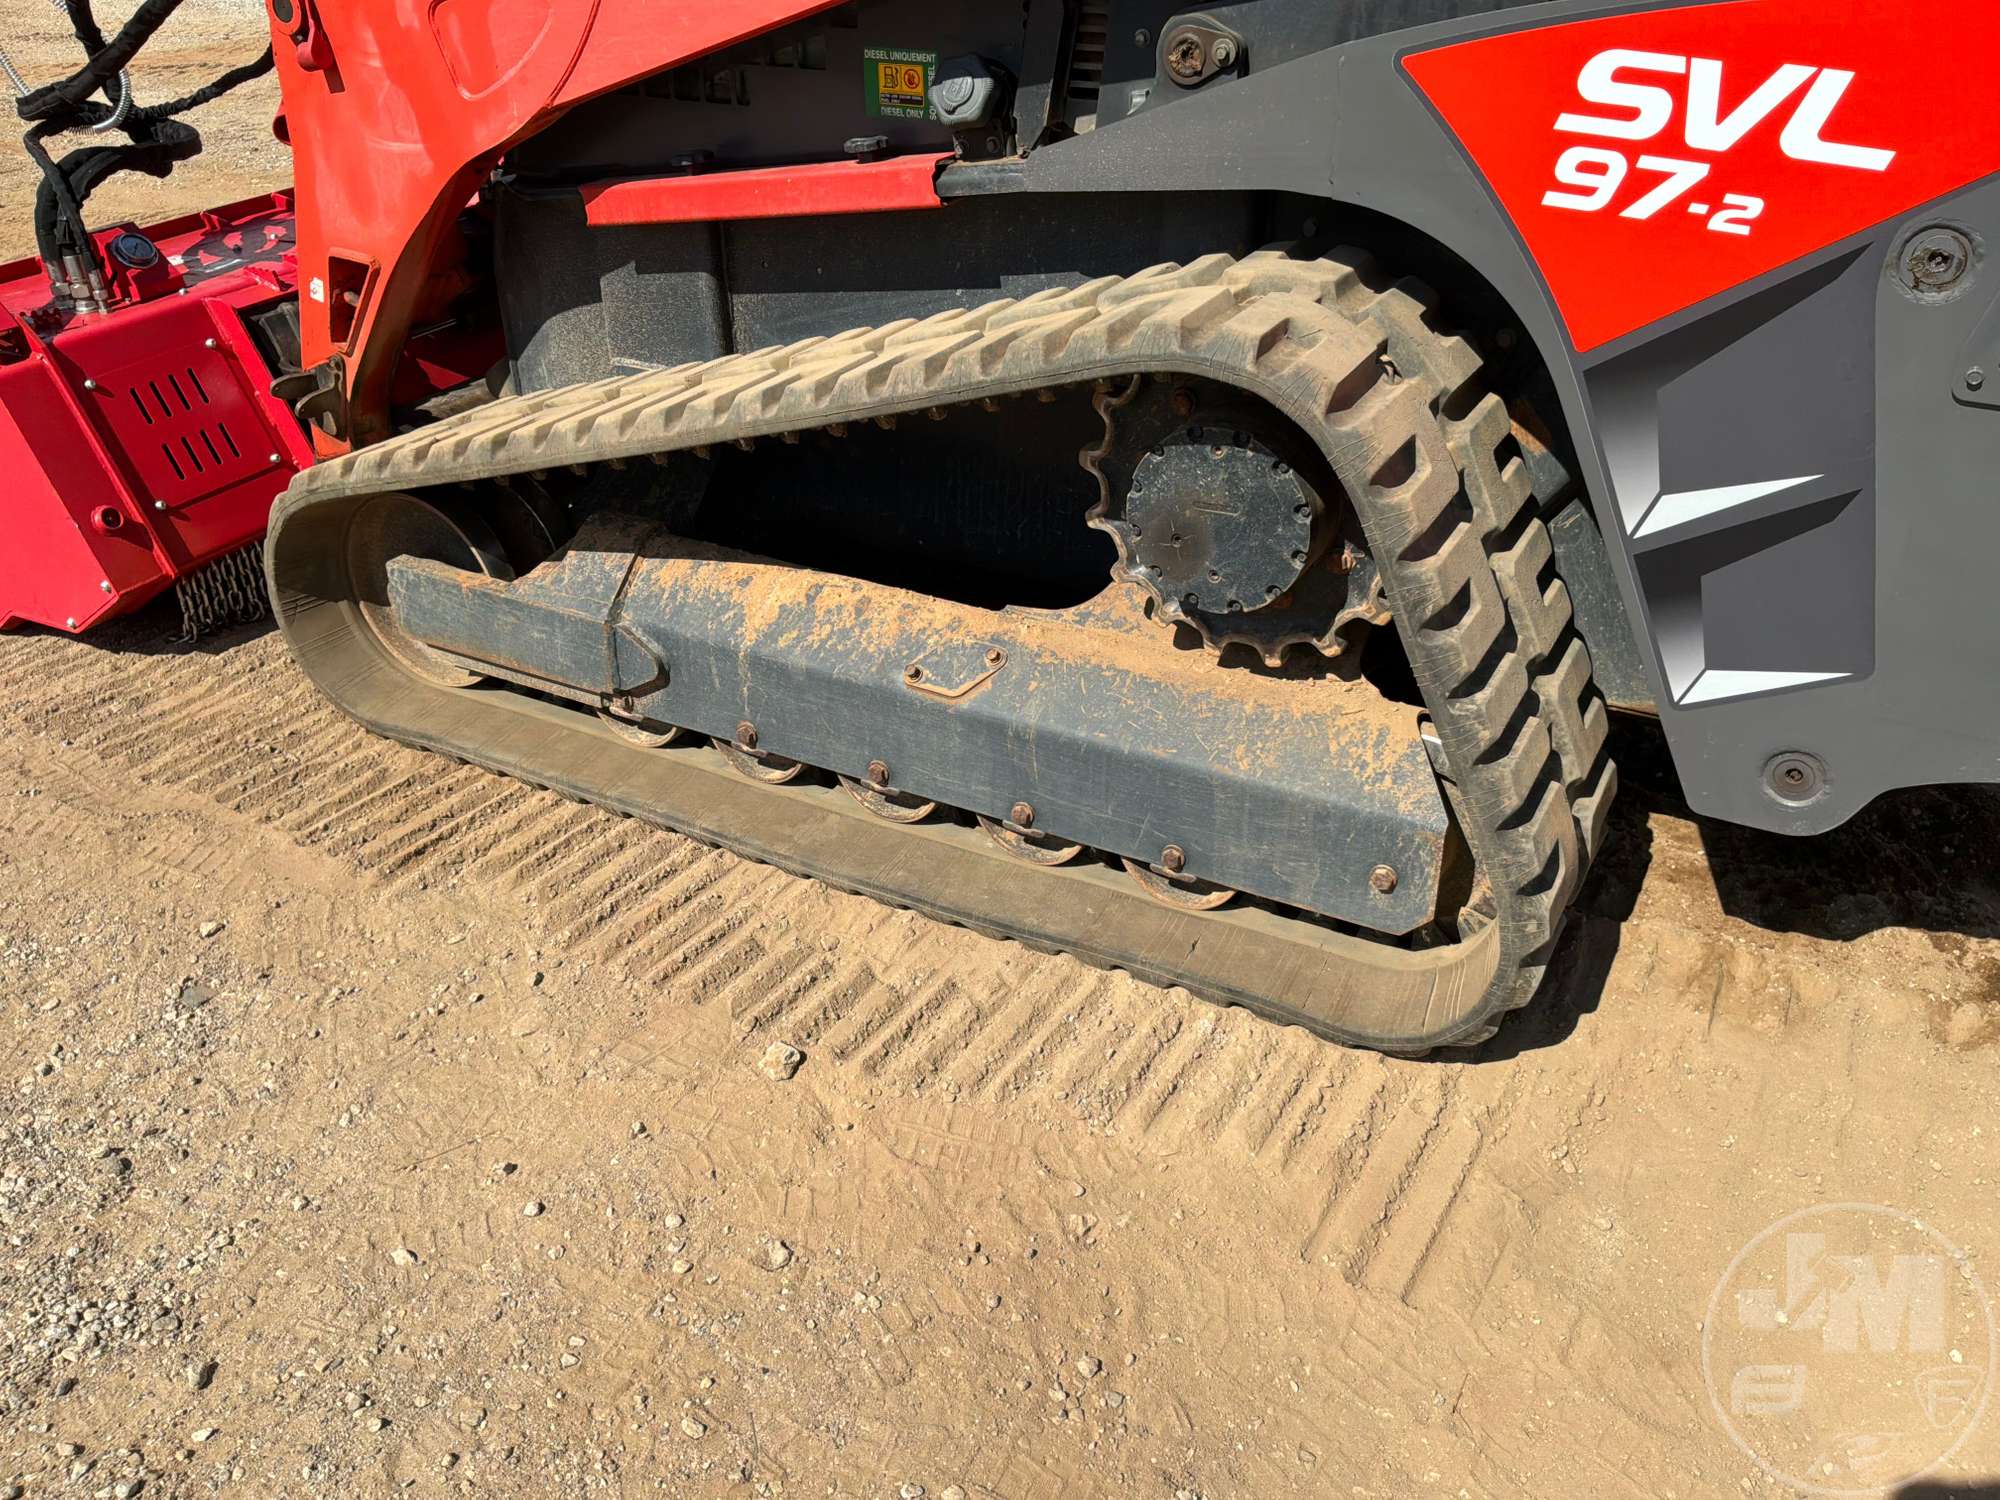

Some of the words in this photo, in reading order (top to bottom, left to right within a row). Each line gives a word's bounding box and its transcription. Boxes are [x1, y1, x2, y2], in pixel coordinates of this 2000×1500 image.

[864, 49, 889, 60] DIESEL
[889, 51, 936, 63] UNIQUEMENT
[880, 106, 905, 118] DIESEL
[905, 108, 924, 119] ONLY
[1553, 49, 1897, 171] SVL
[1541, 146, 1765, 236] 97-2
